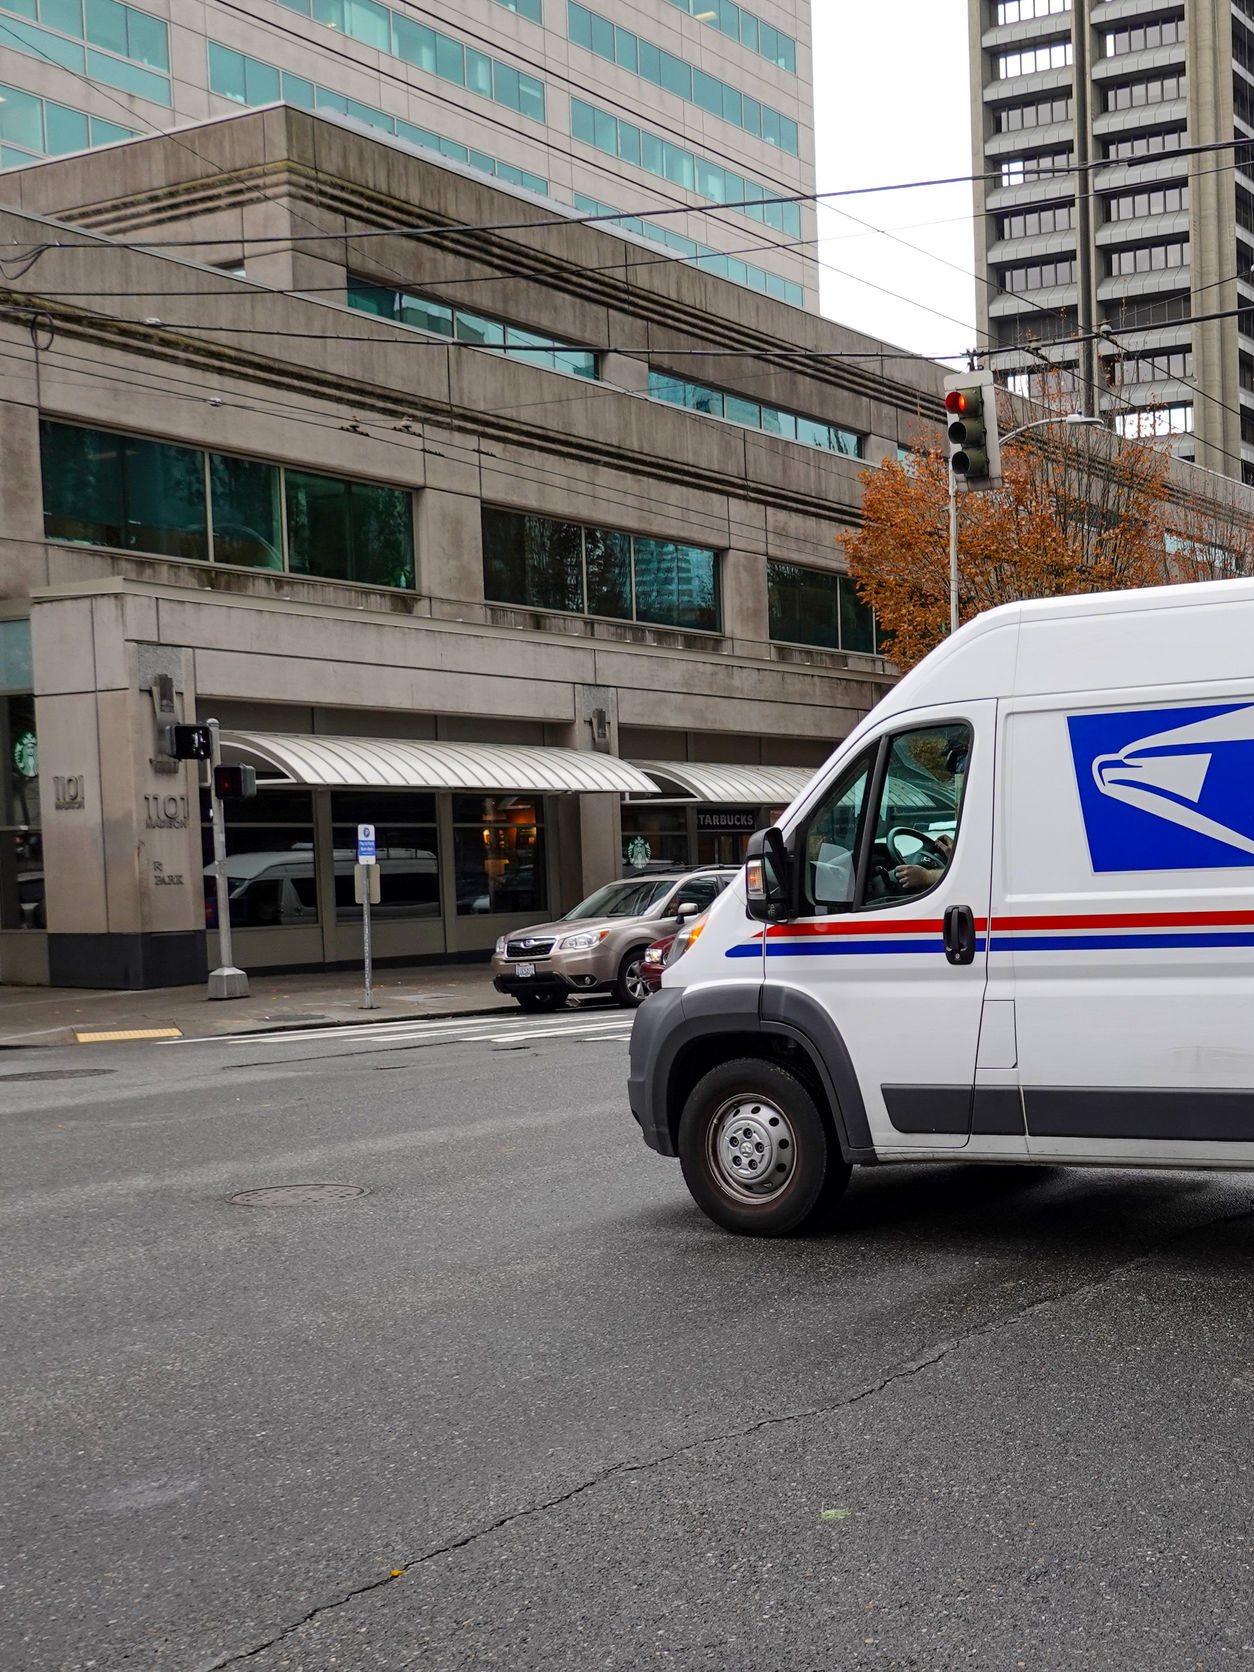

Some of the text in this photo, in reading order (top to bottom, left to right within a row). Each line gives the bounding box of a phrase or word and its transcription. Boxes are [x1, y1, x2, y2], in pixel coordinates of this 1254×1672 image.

[53, 775, 85, 801] 1101
[144, 794, 189, 820] 1101
[697, 815, 754, 826] TARBUCKS
